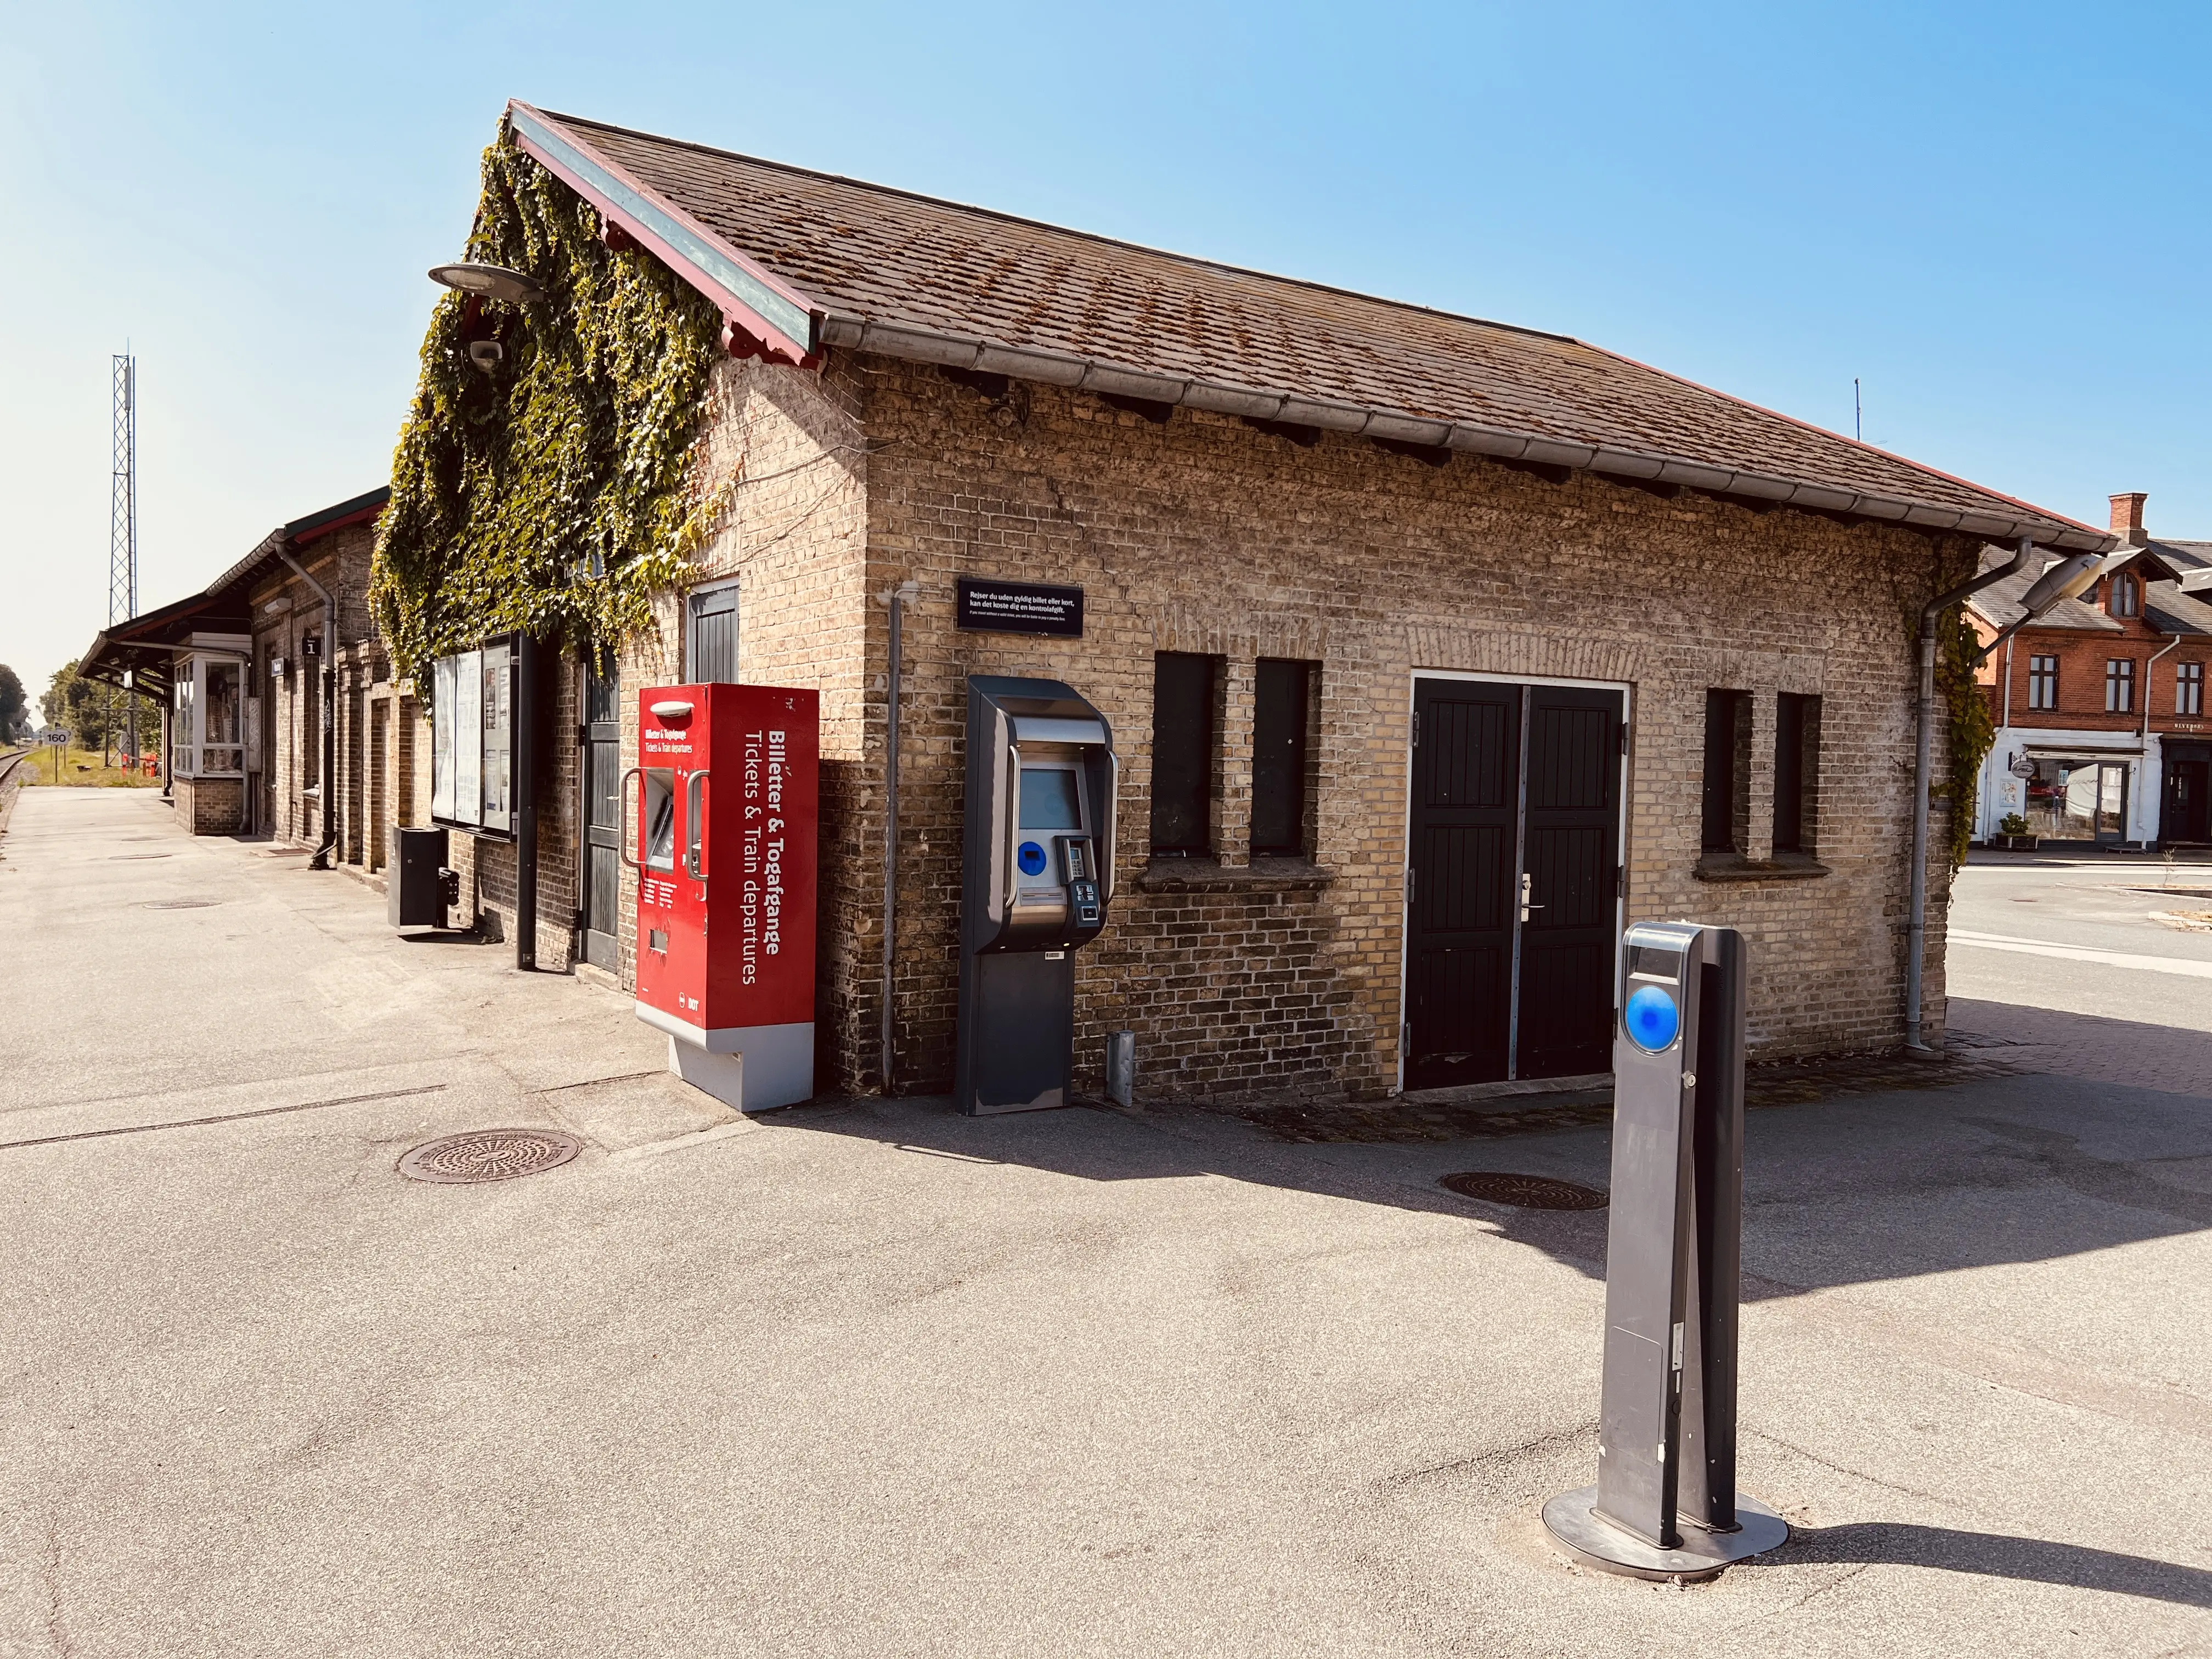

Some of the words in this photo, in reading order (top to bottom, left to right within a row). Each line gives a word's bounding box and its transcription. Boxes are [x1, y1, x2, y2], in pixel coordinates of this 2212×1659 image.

[970, 591, 989, 600] Rejser
[1014, 595, 1032, 603] gyldig
[1061, 599, 1075, 607] kort,
[1029, 604, 1065, 614] kontrolafgift.
[308, 644, 315, 654] 1
[47, 734, 66, 742] 160
[645, 742, 658, 752] Tickets
[658, 742, 662, 753] &
[661, 742, 671, 753] Train
[671, 742, 692, 755] departures
[745, 730, 763, 798] Tickets
[768, 731, 786, 812] Billetter
[744, 805, 761, 820] &
[768, 817, 785, 833] &
[744, 826, 761, 873] Train
[763, 838, 784, 955] Togafgange
[740, 880, 761, 985] departures
[688, 997, 699, 1012] DOT
